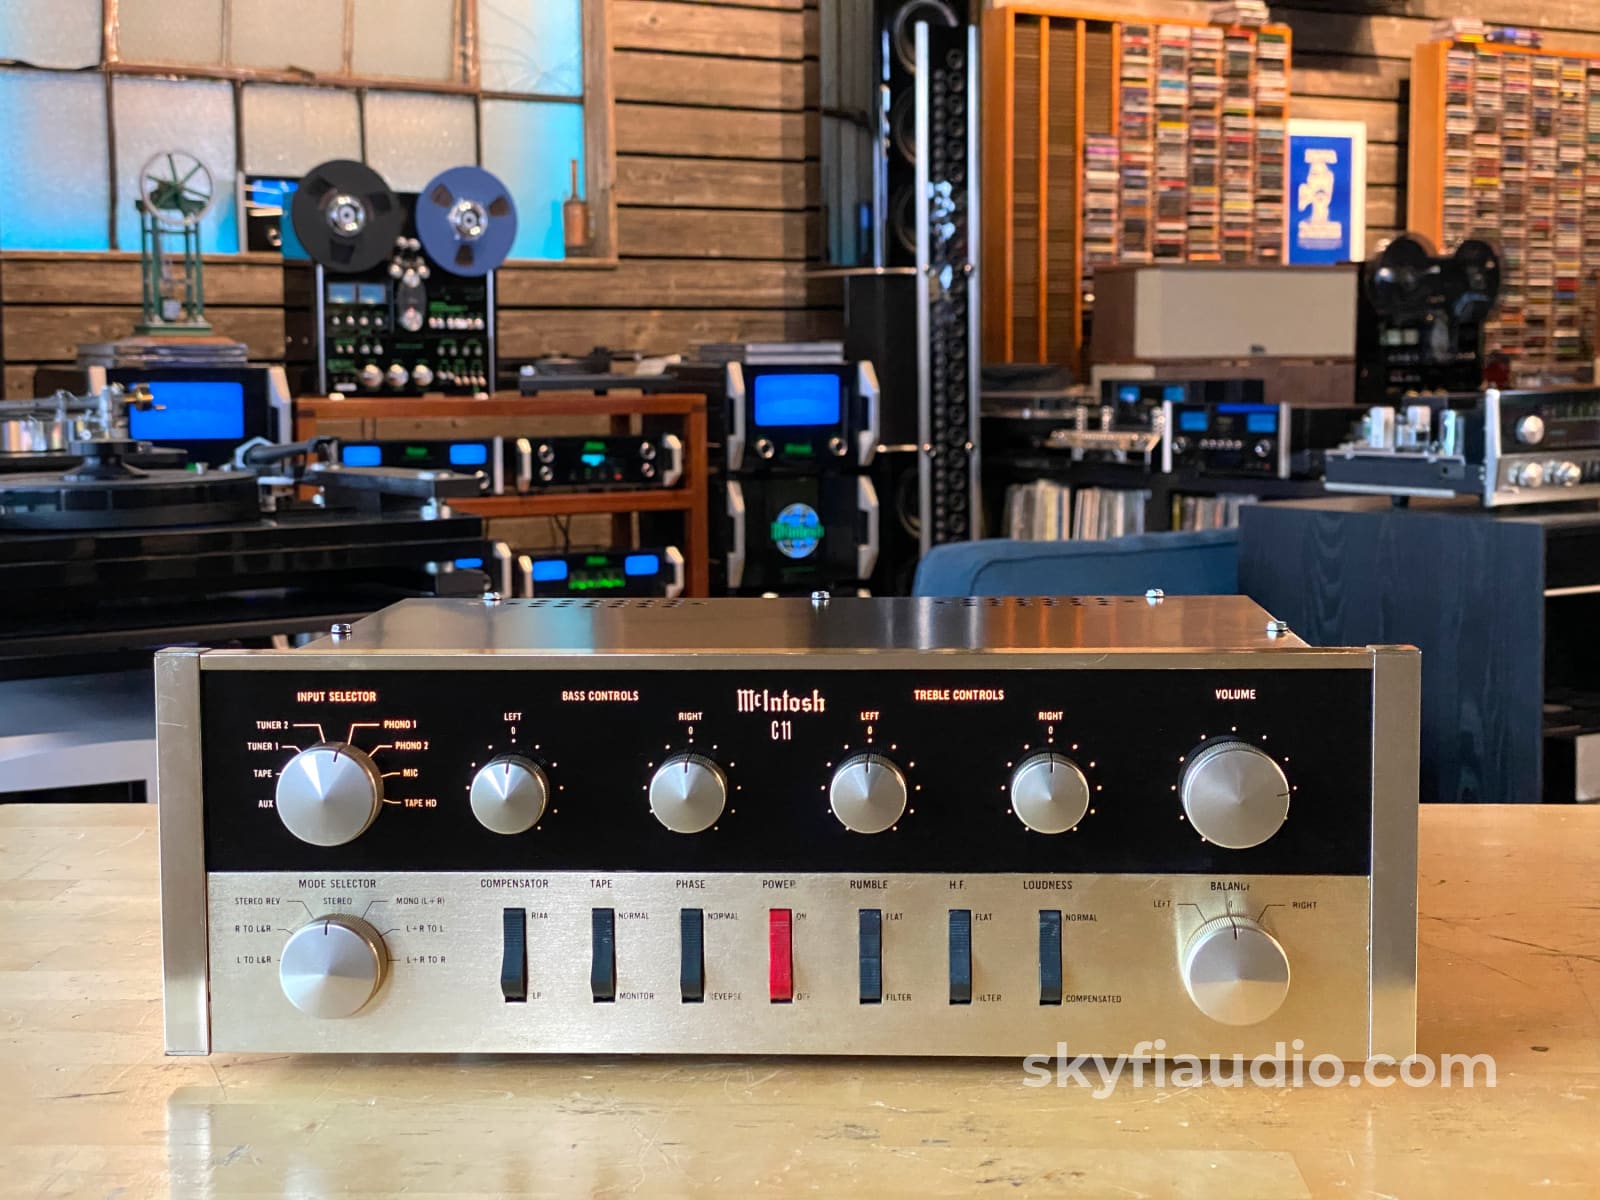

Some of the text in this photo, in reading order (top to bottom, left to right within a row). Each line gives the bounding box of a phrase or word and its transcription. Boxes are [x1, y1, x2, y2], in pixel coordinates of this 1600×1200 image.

[296, 690, 377, 703] INPUT SELECTOR
[561, 690, 640, 702] BASS CONTROLS
[913, 689, 1005, 701] TREBLE CONTROLS
[1215, 688, 1257, 700] VOLUME
[737, 689, 825, 712] McIntosh
[503, 712, 523, 722] LEFT
[678, 711, 703, 721] RIGHT
[860, 711, 880, 721] LEFT
[1038, 711, 1064, 721] RIGHT
[255, 720, 289, 730] TUNER 2
[383, 719, 417, 730] PHONO 1
[247, 741, 279, 751] TUNER 1
[394, 740, 429, 751] PHONO 2
[253, 768, 273, 778] TAPE
[402, 768, 419, 778] MIC
[258, 799, 274, 809] AUX
[404, 798, 438, 808] TAPE HD
[298, 878, 377, 889] MODE SELECTOR
[480, 878, 549, 889] COMPENSATOR
[589, 879, 613, 889] TAPE
[675, 879, 706, 889] PHASE
[762, 879, 796, 889] POWER
[849, 879, 889, 890] RUMBLE
[949, 879, 964, 890] H.F.
[1023, 879, 1073, 890] LOUDNESS
[234, 896, 281, 906] STEREO REV
[323, 896, 353, 905] STEREO
[396, 896, 419, 905] MONO
[1153, 899, 1171, 909] LEFT
[1292, 901, 1317, 910] RIGHT
[531, 911, 549, 920] RIAA
[618, 911, 649, 920] NORMAL
[707, 912, 738, 921] NORMAL
[794, 912, 807, 922] ON
[885, 912, 903, 921] FLAT
[975, 912, 993, 921] FLAT
[1065, 913, 1098, 922] NORMAL
[234, 924, 241, 933] R
[243, 924, 254, 934] TO
[427, 924, 437, 933] TO
[439, 924, 444, 933] L
[236, 956, 241, 964] L
[244, 955, 255, 965] TO
[427, 955, 438, 965] TO
[440, 955, 446, 964] R
[619, 991, 655, 1000] MONITOR
[885, 992, 912, 1002] FILTER
[1065, 994, 1122, 1004] COMPENSATED
